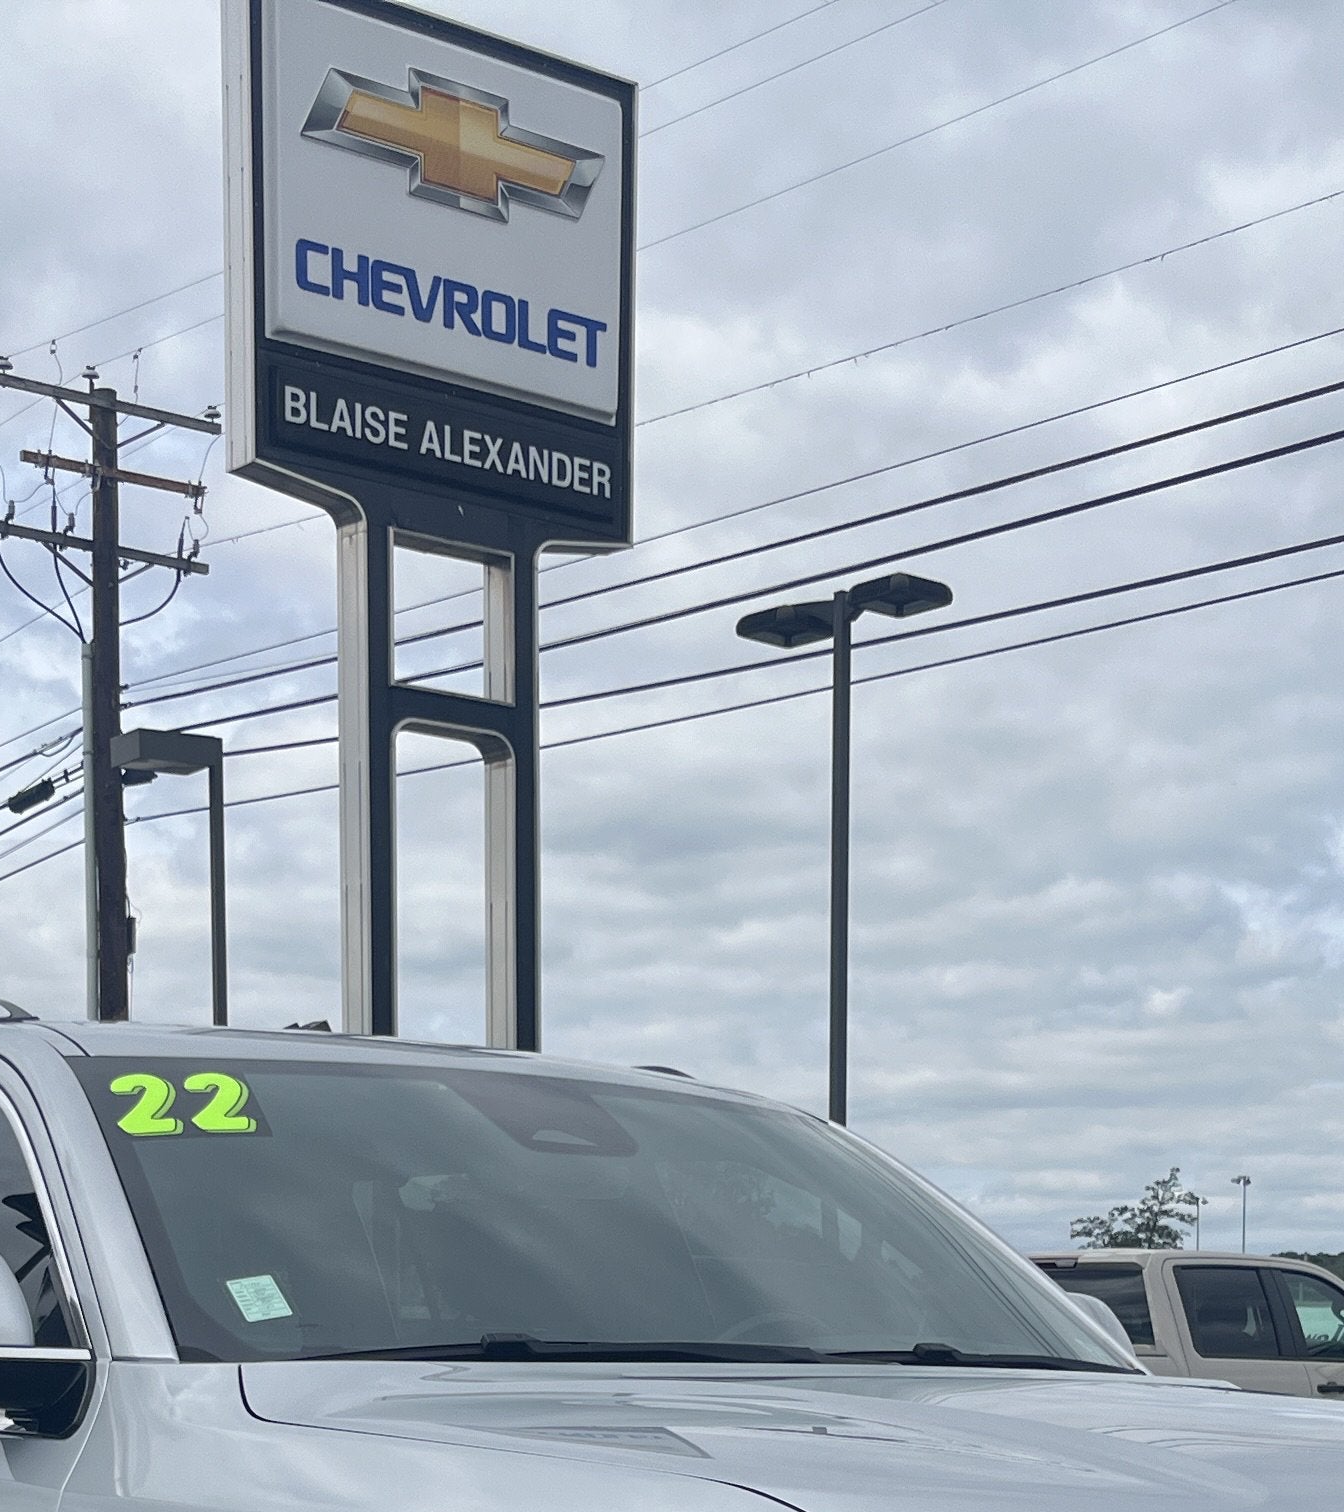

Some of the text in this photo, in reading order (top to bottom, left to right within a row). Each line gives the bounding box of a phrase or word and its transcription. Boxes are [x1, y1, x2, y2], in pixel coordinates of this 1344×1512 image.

[296, 238, 607, 367] CHEVROLET
[284, 385, 612, 498] BLAISE ALEXANDER
[110, 1073, 256, 1136] 22
